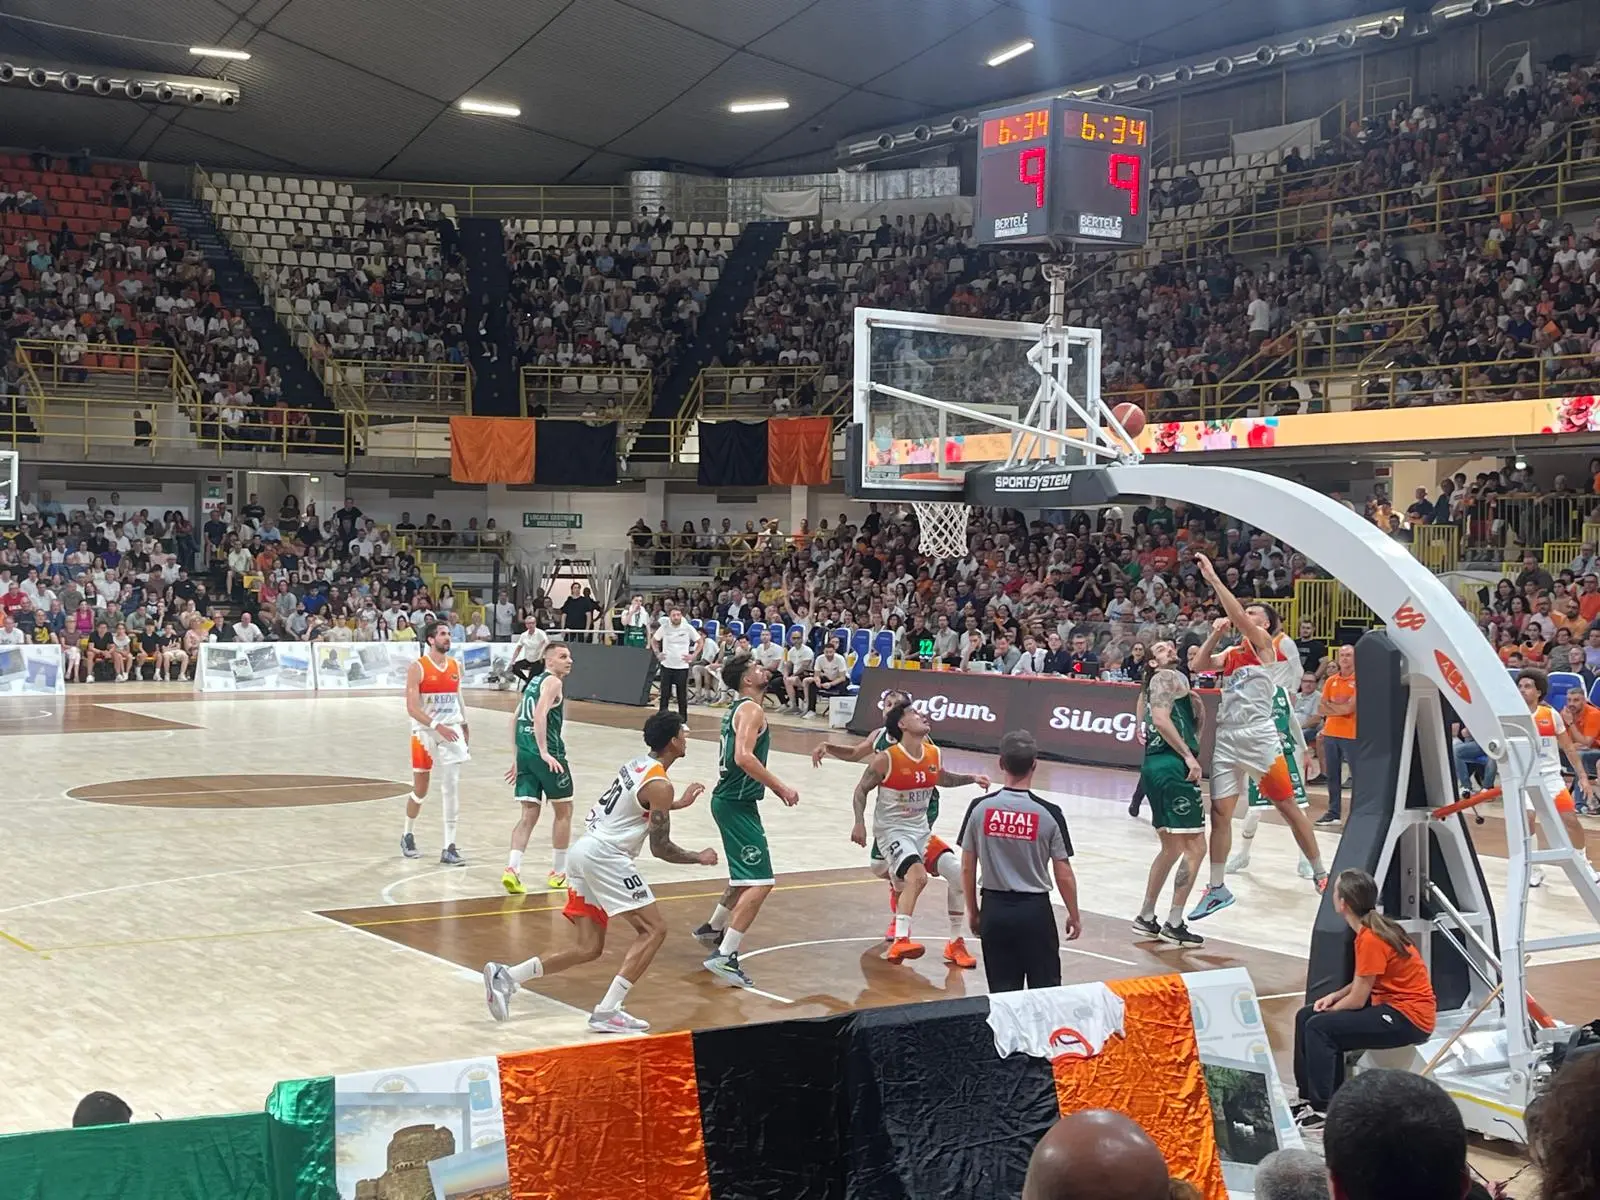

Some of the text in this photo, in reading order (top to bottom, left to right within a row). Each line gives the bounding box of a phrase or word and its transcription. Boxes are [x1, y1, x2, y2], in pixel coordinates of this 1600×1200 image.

[998, 110, 1049, 145] 6:34
[1081, 112, 1147, 145] 6:34
[1019, 147, 1046, 208] 9
[1108, 153, 1141, 215] 9
[995, 473, 1072, 491] SPORTSYSTEM
[919, 639, 933, 655] 22
[1441, 661, 1464, 694] ACE
[877, 688, 997, 722] aGum
[914, 771, 927, 783] 33
[988, 822, 1033, 835] GROUP
[990, 810, 1034, 827] ATTAL
[623, 874, 643, 890] 00
